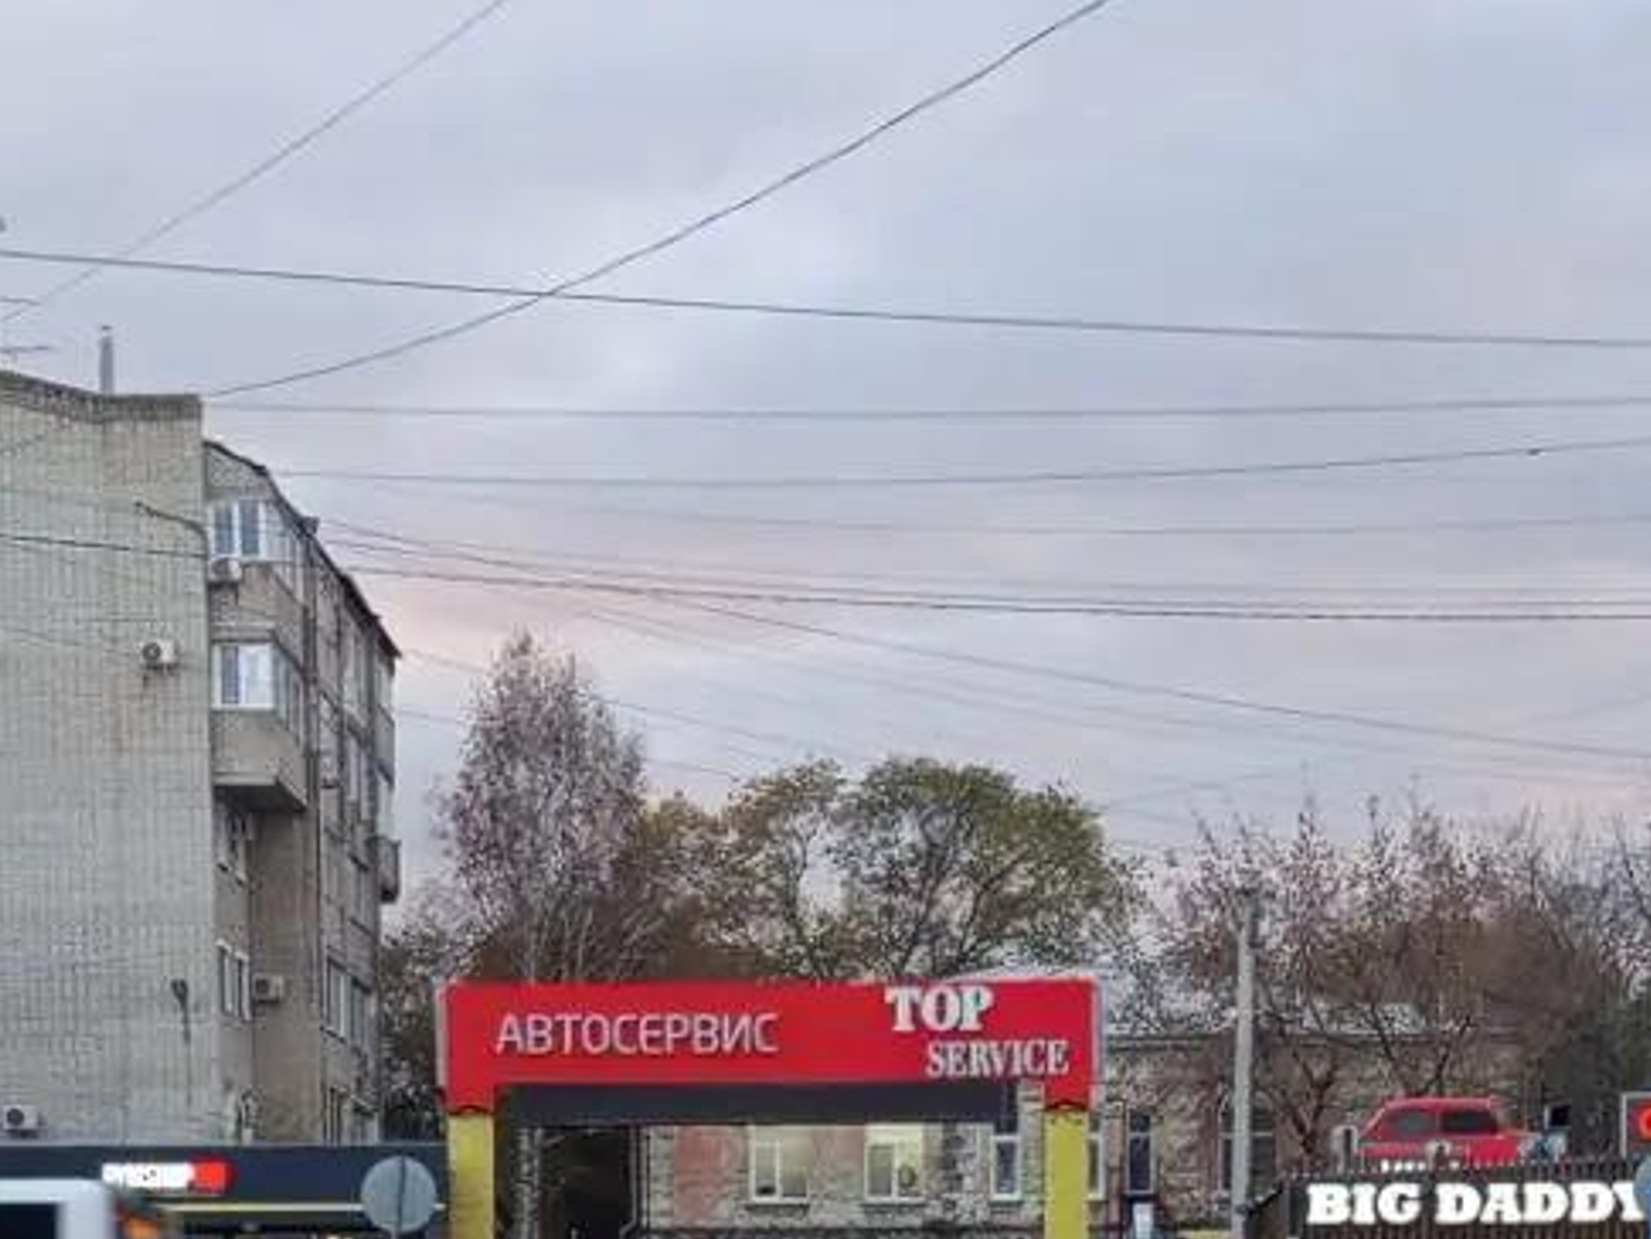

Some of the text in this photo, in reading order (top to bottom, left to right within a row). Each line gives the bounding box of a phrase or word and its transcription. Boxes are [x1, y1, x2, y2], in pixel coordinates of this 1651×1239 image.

[883, 985, 993, 1032] TOP
[495, 1013, 777, 1054] АВТОСЕРВИС
[926, 1039, 1069, 1077] SERVICE
[1306, 1182, 1645, 1225] BIG DADDY
